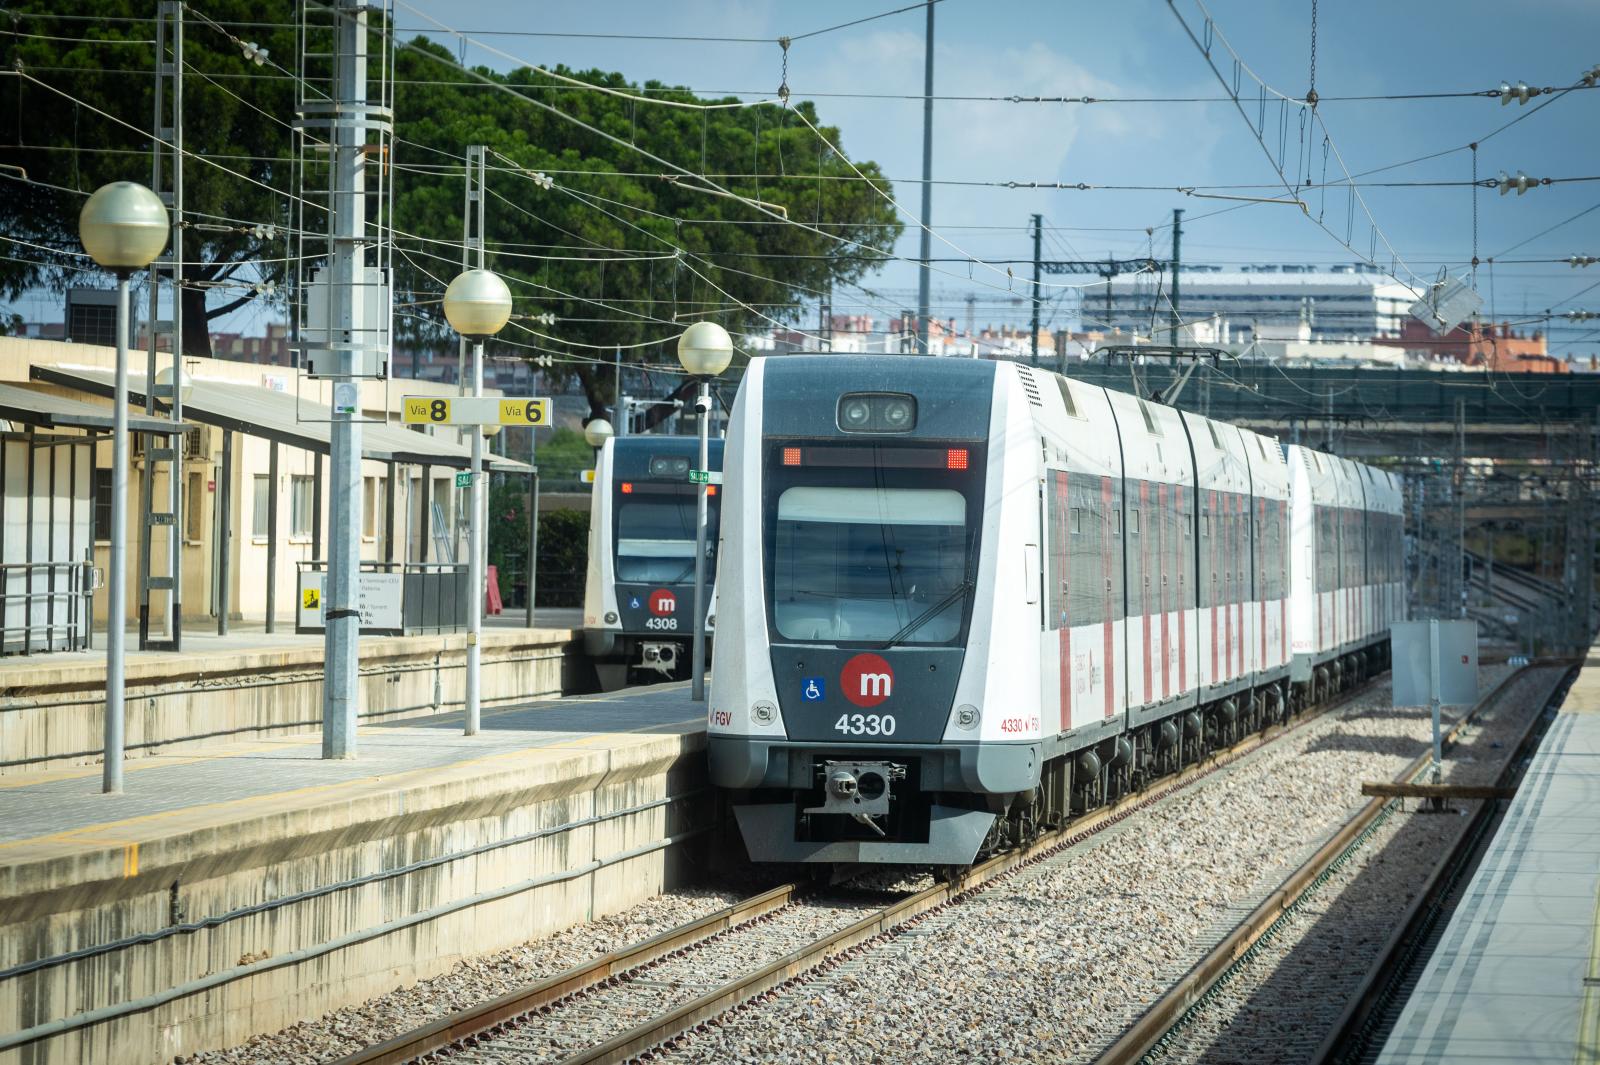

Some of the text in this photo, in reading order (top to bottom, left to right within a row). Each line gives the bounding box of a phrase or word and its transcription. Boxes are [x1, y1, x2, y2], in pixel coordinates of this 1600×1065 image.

[410, 399, 447, 422] Via 8
[505, 400, 542, 423] Via 6
[658, 598, 675, 612] m
[645, 618, 677, 630] 4308
[860, 672, 891, 697] m
[715, 711, 732, 726] FGV
[834, 713, 896, 736] 4330
[1001, 718, 1023, 733] 4330
